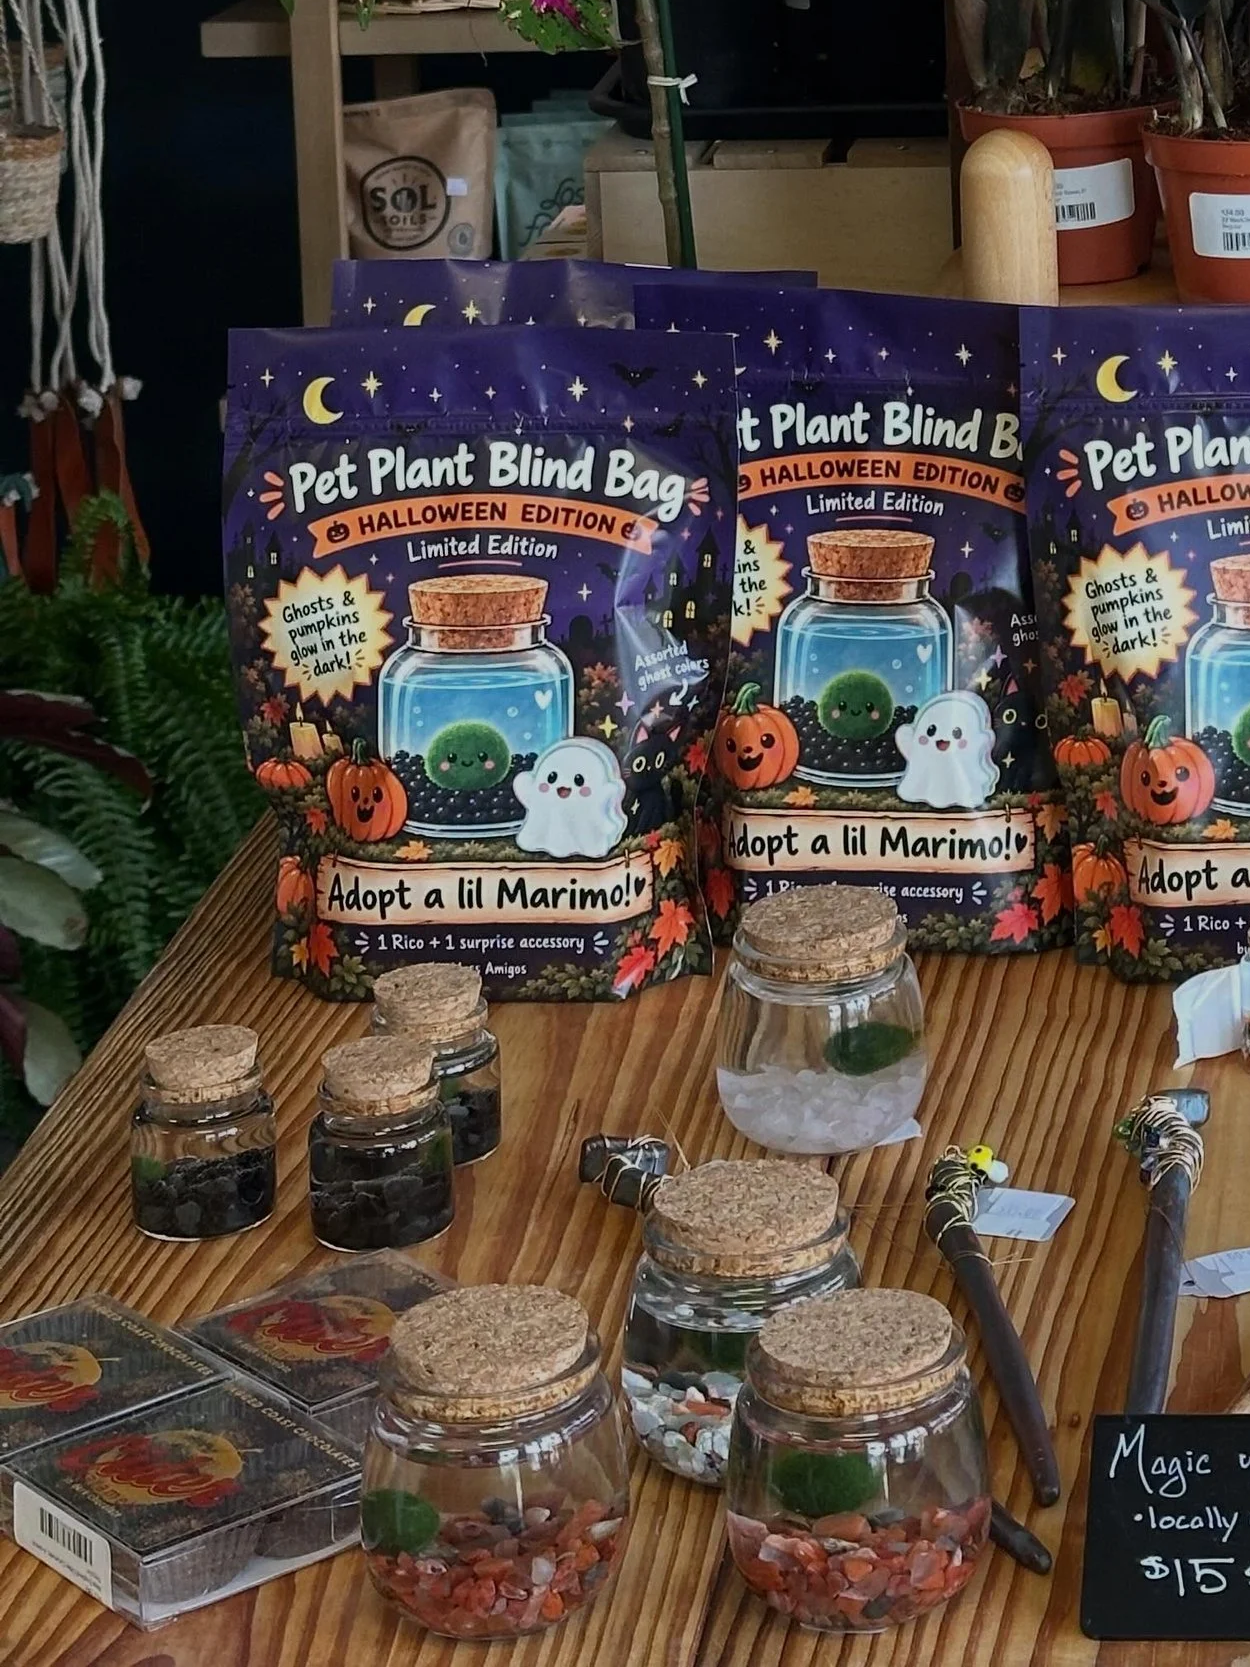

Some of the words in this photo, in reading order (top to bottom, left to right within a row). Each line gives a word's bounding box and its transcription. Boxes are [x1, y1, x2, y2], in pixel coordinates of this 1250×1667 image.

[370, 184, 437, 213] SOL
[769, 402, 870, 450] Plant
[883, 402, 982, 453] Blind
[760, 459, 901, 488] HALLOWEEN
[912, 462, 1000, 495] EDITION
[1083, 430, 1157, 491] Pet
[289, 453, 359, 514] Pet
[367, 441, 476, 497] Plant
[488, 440, 595, 492] Blind
[603, 449, 687, 523] Bag
[357, 501, 507, 536] HALLOWEEN
[521, 503, 617, 534] EDITION
[806, 491, 876, 516] Limited
[882, 492, 945, 516] Edition
[407, 533, 481, 563] Limited
[487, 534, 559, 560] Edition
[743, 539, 756, 555] &
[739, 576, 767, 594] the
[1085, 571, 1138, 600] Ghosts
[1145, 567, 1159, 584] &
[282, 597, 335, 625] Ghosts
[342, 589, 356, 607] &
[1091, 586, 1164, 622] pumpkins
[288, 609, 360, 646] pumpkins
[1091, 617, 1120, 643] glow
[1124, 612, 1140, 629] in
[1144, 603, 1173, 625] the
[290, 640, 319, 666] glow
[321, 637, 336, 653] in
[338, 628, 368, 649] the
[635, 640, 688, 672] Assorted
[1112, 630, 1158, 655] dark!
[312, 652, 353, 677] dark!
[638, 663, 673, 692] ghost
[675, 656, 710, 675] colors
[727, 823, 799, 866] Adopt
[810, 833, 830, 856] a
[842, 824, 866, 857] lil
[879, 825, 1012, 861] Marimo!
[901, 884, 964, 905] accessory
[1137, 854, 1218, 901] Adopt
[1230, 869, 1250, 888] a
[327, 872, 413, 920] Adopt
[424, 887, 445, 910] a
[458, 877, 482, 910] lil
[497, 872, 631, 911] Marimo!
[1184, 915, 1194, 932] 1
[1198, 914, 1230, 932] Rico
[1235, 917, 1247, 930] +
[377, 934, 388, 951] 1
[392, 933, 424, 951] Rico
[429, 936, 440, 950] +
[445, 934, 454, 951] 1
[460, 934, 515, 954] surprise
[519, 934, 585, 954] accessory
[485, 961, 527, 979] Amigos
[150, 1336, 215, 1378] CHOCOLATES
[261, 1405, 296, 1430] COAST
[293, 1425, 361, 1471] CHOCOLATES
[1109, 1423, 1212, 1498] Magic
[1140, 1555, 1235, 1597] $15
